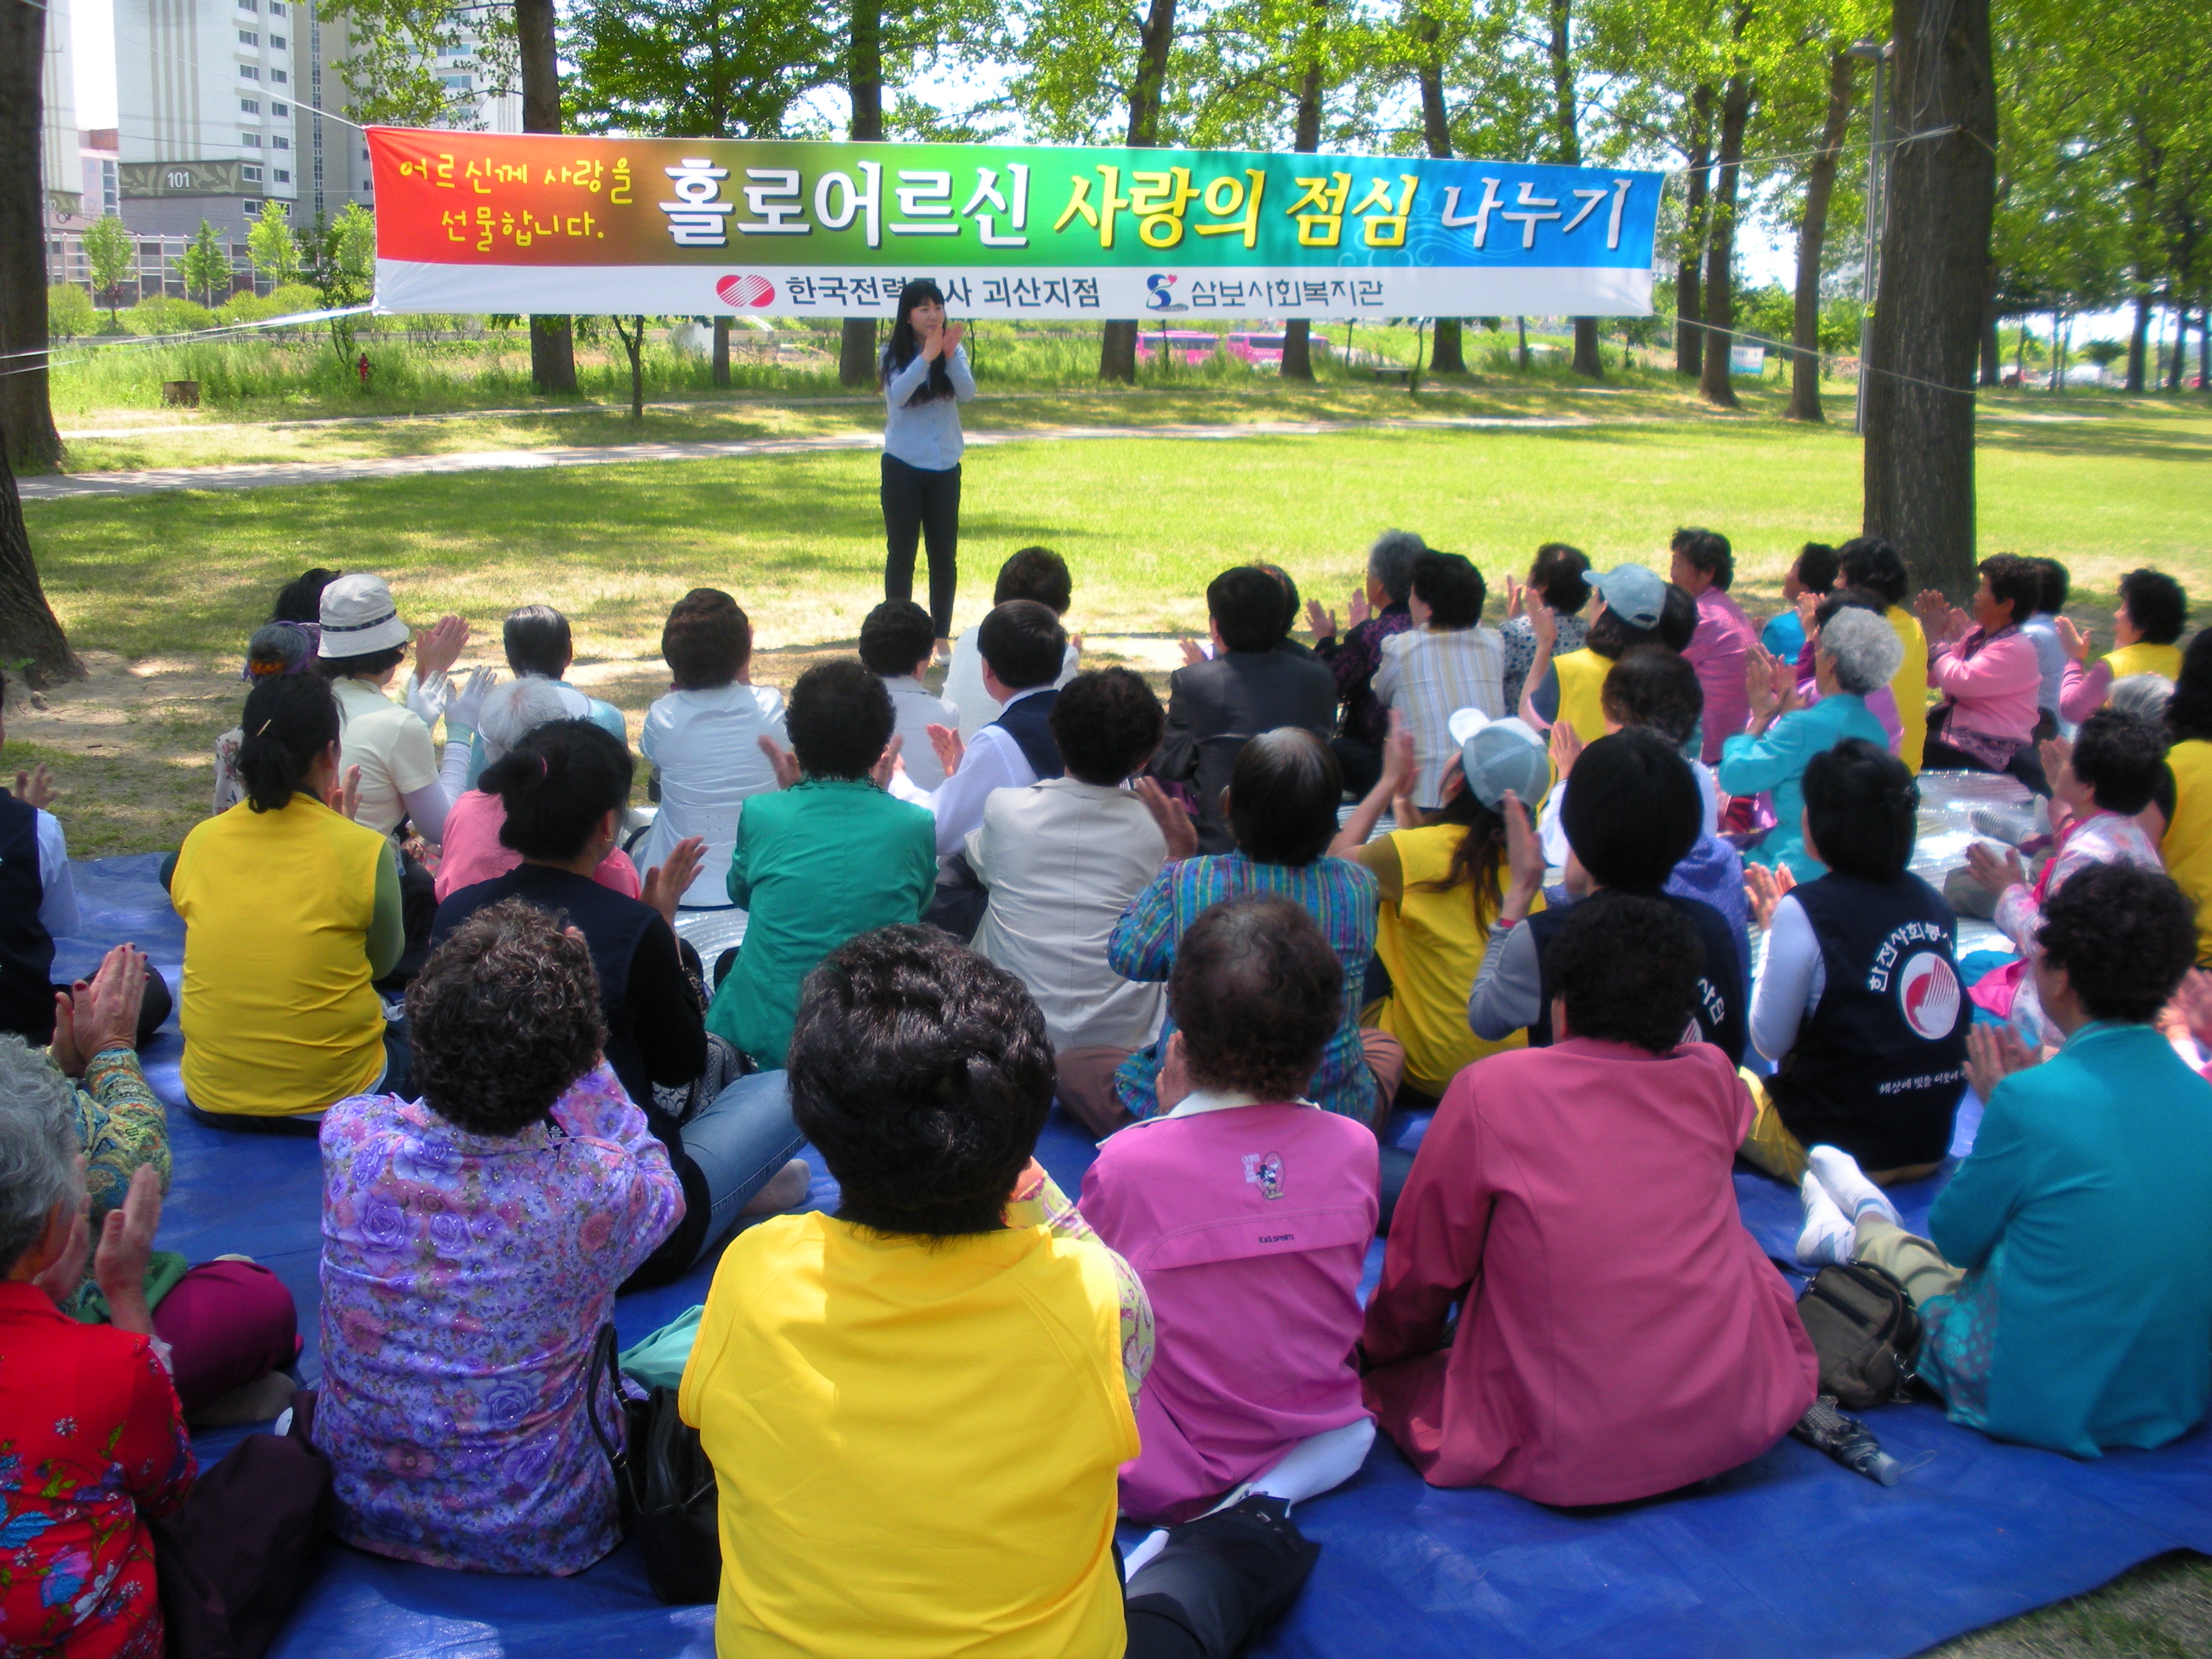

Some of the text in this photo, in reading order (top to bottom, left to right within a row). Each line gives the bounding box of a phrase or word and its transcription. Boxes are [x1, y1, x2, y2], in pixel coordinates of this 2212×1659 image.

[167, 172, 190, 189] 101
[399, 153, 633, 204] 어르신께 사랑을
[659, 158, 1633, 249] 홀로어르신 사랑의 점심 나누기
[441, 206, 605, 252] 선물합니다.
[785, 276, 1101, 308] 한국전력사 괴산지점
[1191, 279, 1384, 307] 삼보사회복지관
